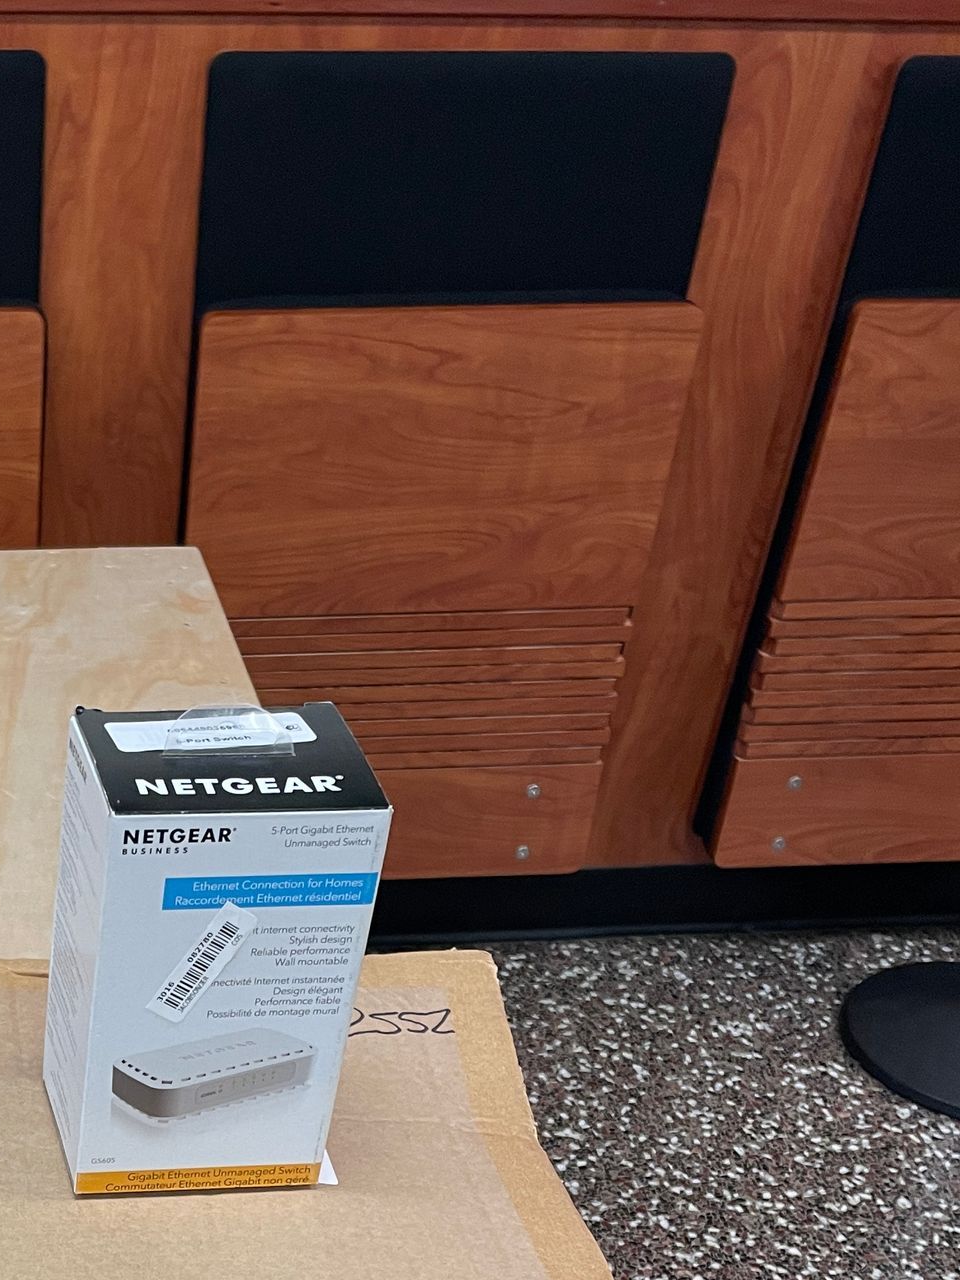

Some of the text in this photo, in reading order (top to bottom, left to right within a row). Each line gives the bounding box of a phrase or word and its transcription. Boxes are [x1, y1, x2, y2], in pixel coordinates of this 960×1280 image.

[134, 775, 343, 797] NETGEAR
[123, 828, 232, 845] NETGEAR
[271, 824, 374, 837] 5-Port Gigabit Ethernet
[284, 838, 371, 849] Unmanaged Switch
[122, 847, 188, 856] BUSINESS
[192, 878, 364, 892] Ethernet Connection for Homes
[256, 893, 303, 904] Ethernet
[304, 891, 362, 902] résidentiel
[260, 925, 297, 935] internet
[299, 925, 355, 935] connectivity
[289, 935, 353, 947] Stylish design
[250, 946, 351, 957] Reliable performance
[275, 957, 349, 967] Wall mountable
[210, 975, 345, 987] nectivité Internet instantanée
[157, 982, 175, 1003] 3016
[273, 985, 343, 997] Design élégant
[254, 996, 341, 1007] Performance fiable
[206, 1007, 340, 1019] Possibilité de montage mural
[127, 1166, 311, 1183] Gigabit Ethernet Unmanaged Switch
[105, 1182, 177, 1192] Commutateur
[178, 1179, 222, 1189] Ethernet
[223, 1177, 262, 1188] Gigabit
[263, 1177, 284, 1185] non
